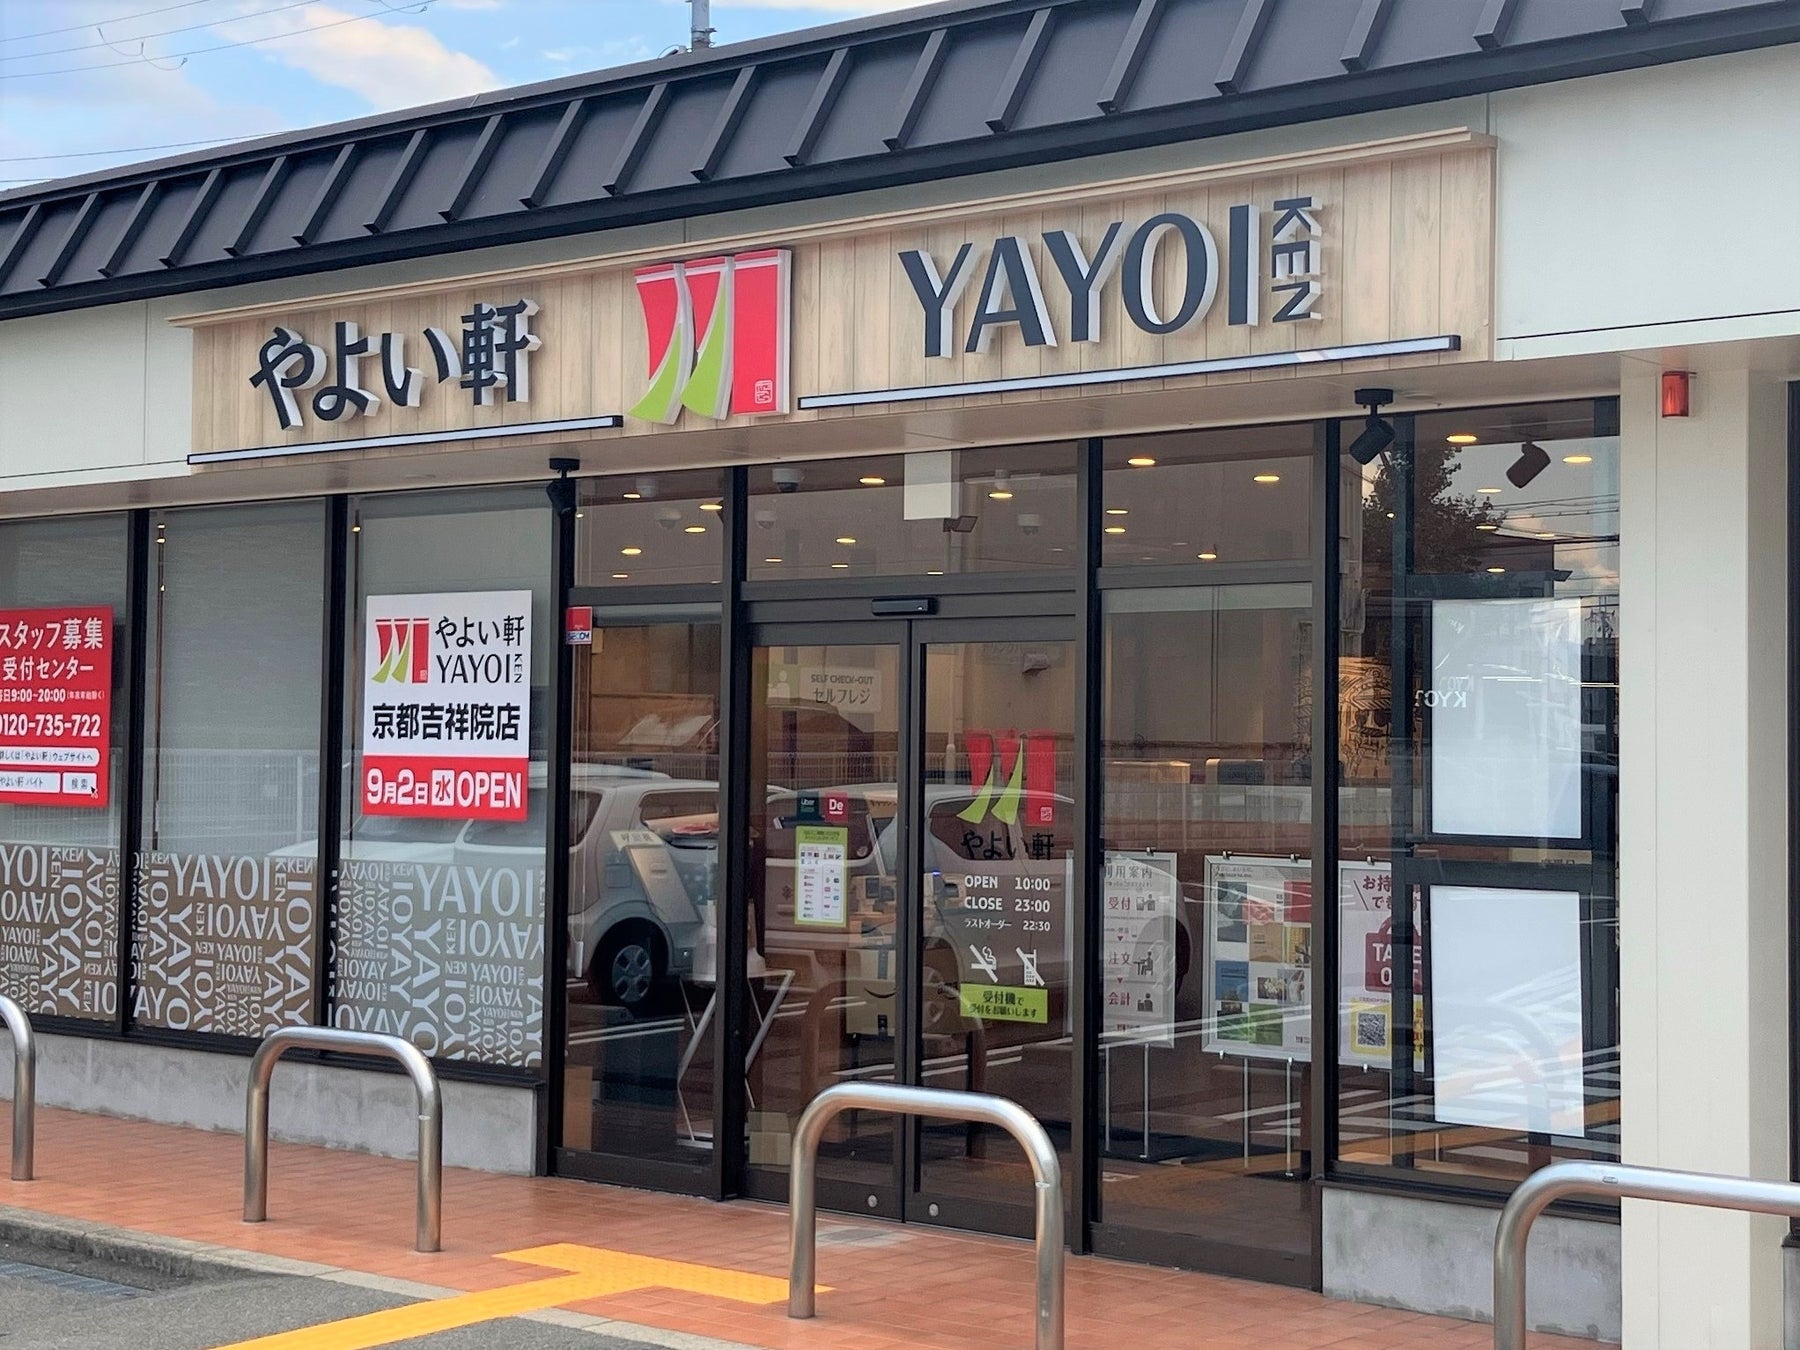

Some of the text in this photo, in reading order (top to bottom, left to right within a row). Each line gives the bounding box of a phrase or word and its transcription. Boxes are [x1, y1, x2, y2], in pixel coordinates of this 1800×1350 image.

[898, 196, 1322, 358] YAYOI KEN
[249, 298, 542, 431] やよい軒
[0, 617, 104, 650] スタッフ募集
[435, 615, 525, 649] やよい軒
[3, 656, 94, 681] 受付センター
[436, 653, 511, 684] YAYOI
[514, 653, 523, 684] KEN
[813, 688, 871, 704] セルフレジ
[372, 702, 521, 741] 京都吉祥院店
[961, 830, 1055, 861] やよい軒
[170, 852, 269, 901] YAYOI
[415, 864, 534, 918] YAYOI
[965, 875, 1050, 891] OPEN 10:00
[964, 896, 1050, 913] CLOSE 23:00
[964, 918, 1051, 932] ラストオーダー 22:30
